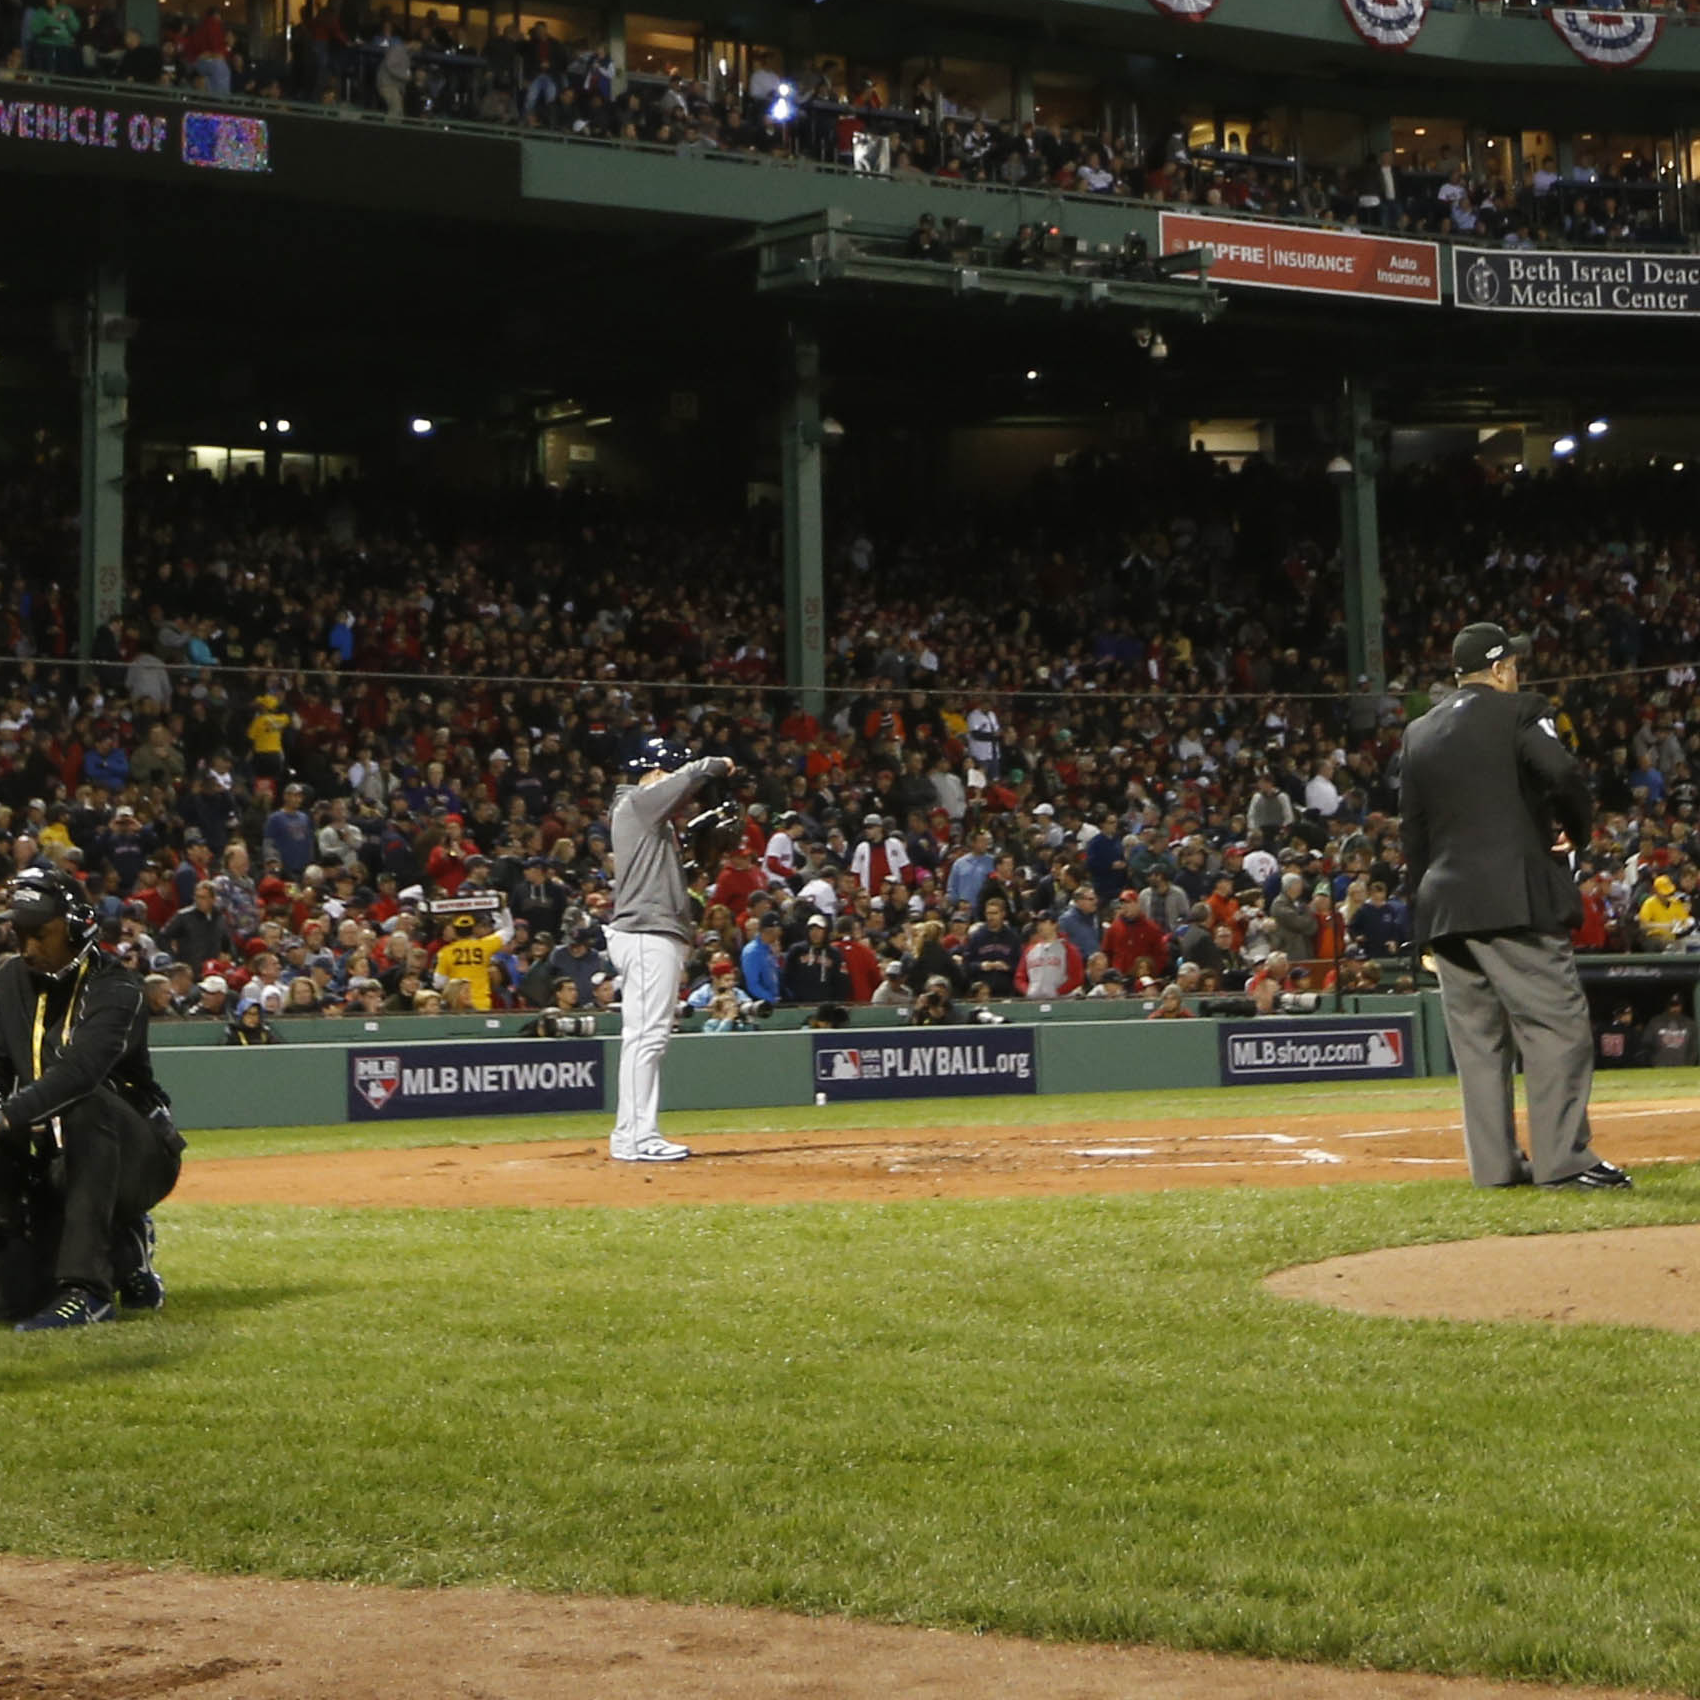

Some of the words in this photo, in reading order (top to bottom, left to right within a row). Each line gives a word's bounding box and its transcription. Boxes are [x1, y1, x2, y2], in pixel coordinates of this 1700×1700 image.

[128, 112, 167, 153] OF
[1273, 249, 1354, 274] INSURANCE
[1390, 254, 1417, 271] Auto
[1508, 257, 1561, 282] Beth
[1571, 259, 1634, 284] Israel
[1377, 269, 1431, 288] Insurance
[1509, 283, 1602, 308] Medical
[1612, 286, 1689, 310] Center
[452, 948, 484, 966] 219
[883, 1045, 1030, 1079] PLAYBALL.org
[1234, 1040, 1363, 1068] MLBshop.com
[357, 1060, 398, 1076] MLB
[402, 1067, 458, 1096] MLB
[463, 1060, 597, 1093] NETWORK
